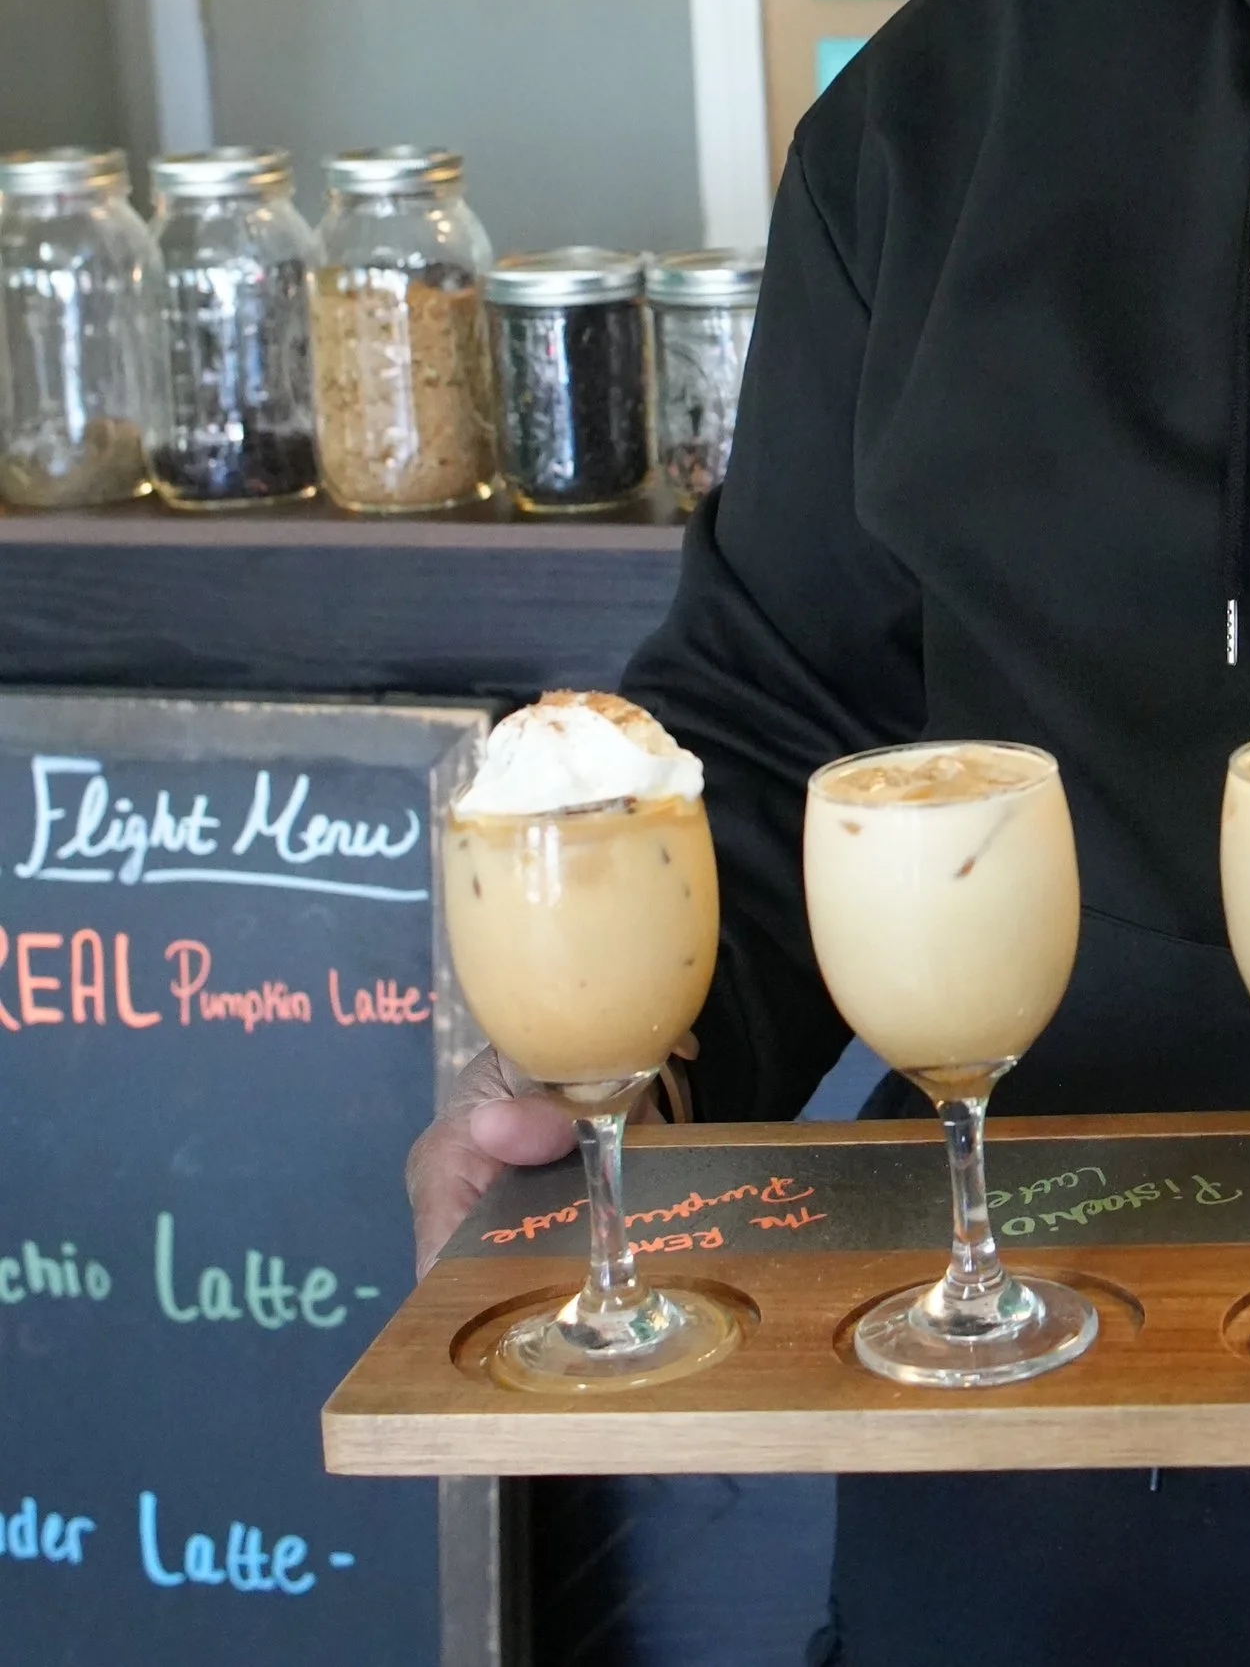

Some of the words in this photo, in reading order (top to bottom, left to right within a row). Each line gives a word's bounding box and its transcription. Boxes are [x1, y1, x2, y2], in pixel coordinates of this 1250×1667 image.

[14, 755, 220, 885] Flight
[232, 770, 420, 863] Menu
[749, 1207, 828, 1229] The
[1001, 1175, 1243, 1235] Pistachio
[0, 1495, 97, 1565] der
